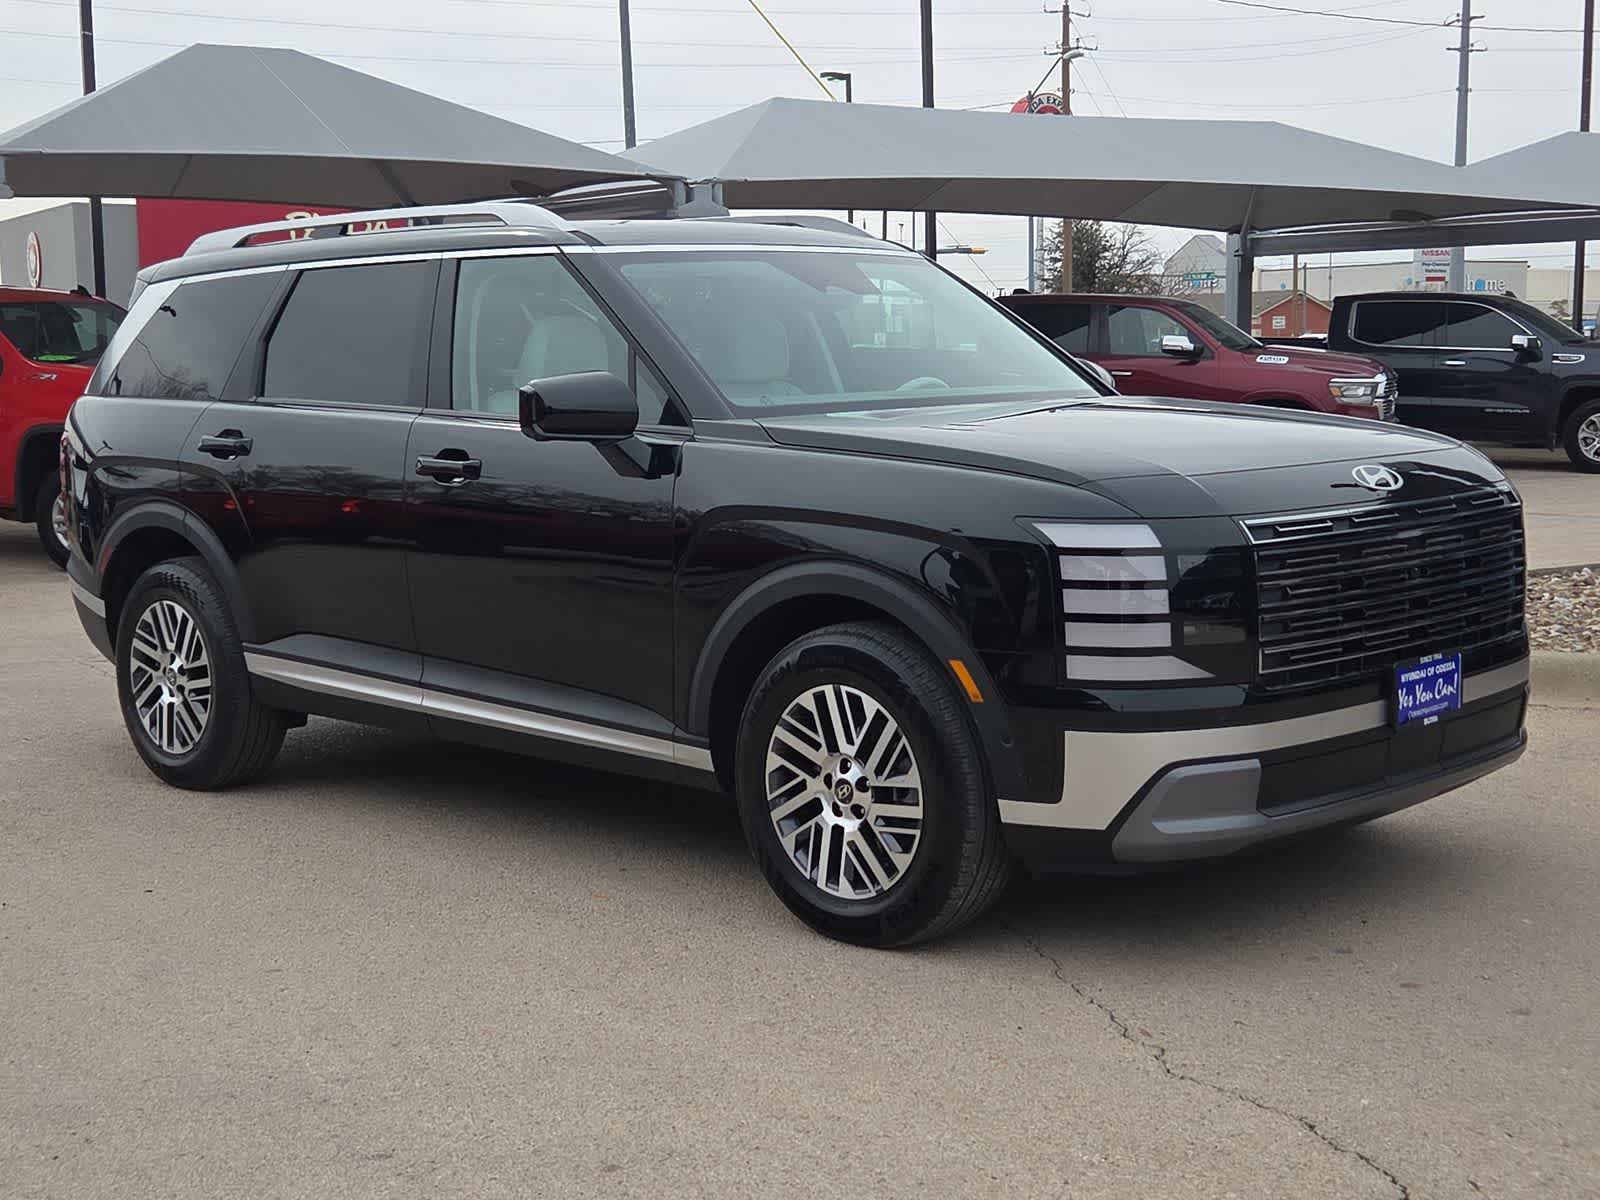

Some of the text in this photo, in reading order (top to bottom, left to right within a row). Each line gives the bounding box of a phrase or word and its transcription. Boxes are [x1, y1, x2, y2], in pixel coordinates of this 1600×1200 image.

[1046, 96, 1064, 110] EXP
[1421, 249, 1450, 257] NISSAN
[1427, 667, 1435, 677] OF
[1398, 672, 1458, 710] Yes You Can!
